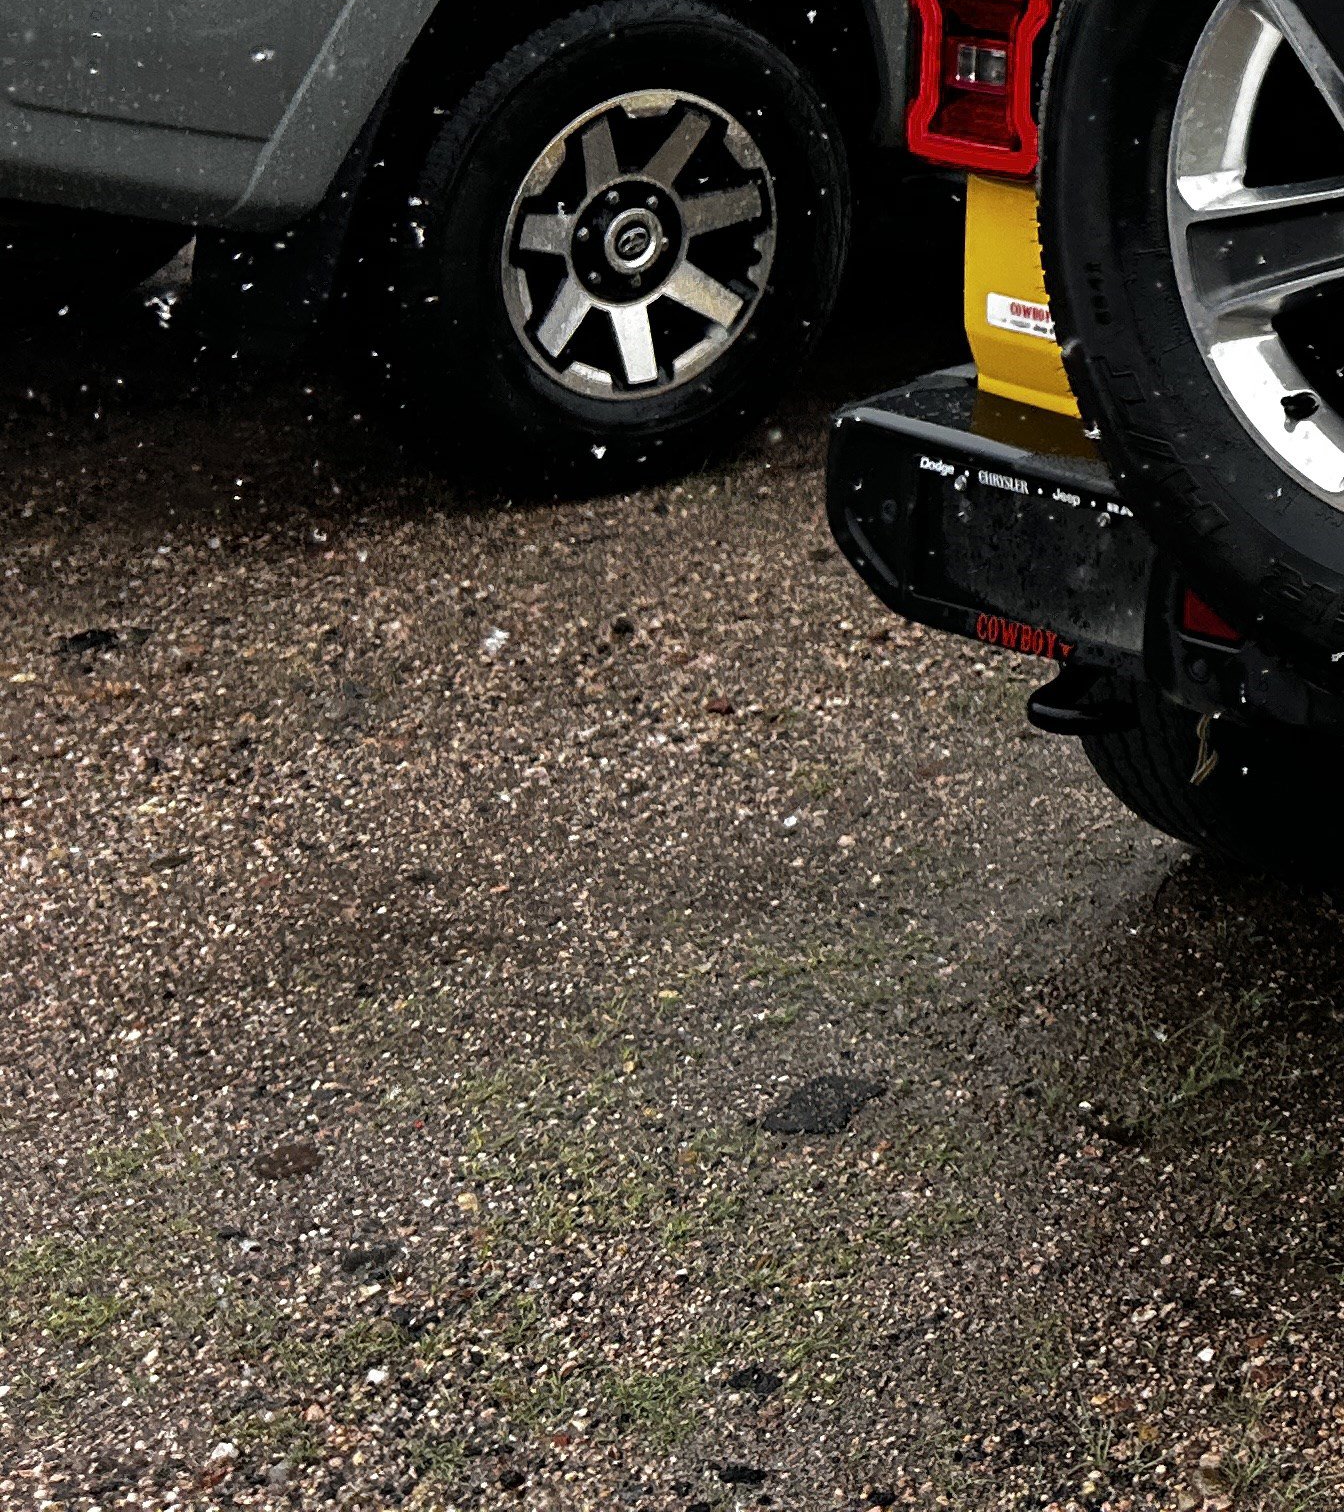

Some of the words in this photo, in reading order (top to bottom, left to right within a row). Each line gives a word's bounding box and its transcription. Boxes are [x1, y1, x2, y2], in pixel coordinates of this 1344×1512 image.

[919, 455, 955, 477] Dodge
[978, 469, 1030, 495] CHRYSLER
[1052, 487, 1081, 508] Jeep
[1106, 501, 1134, 518] RA
[976, 612, 1058, 659] COWBOY
